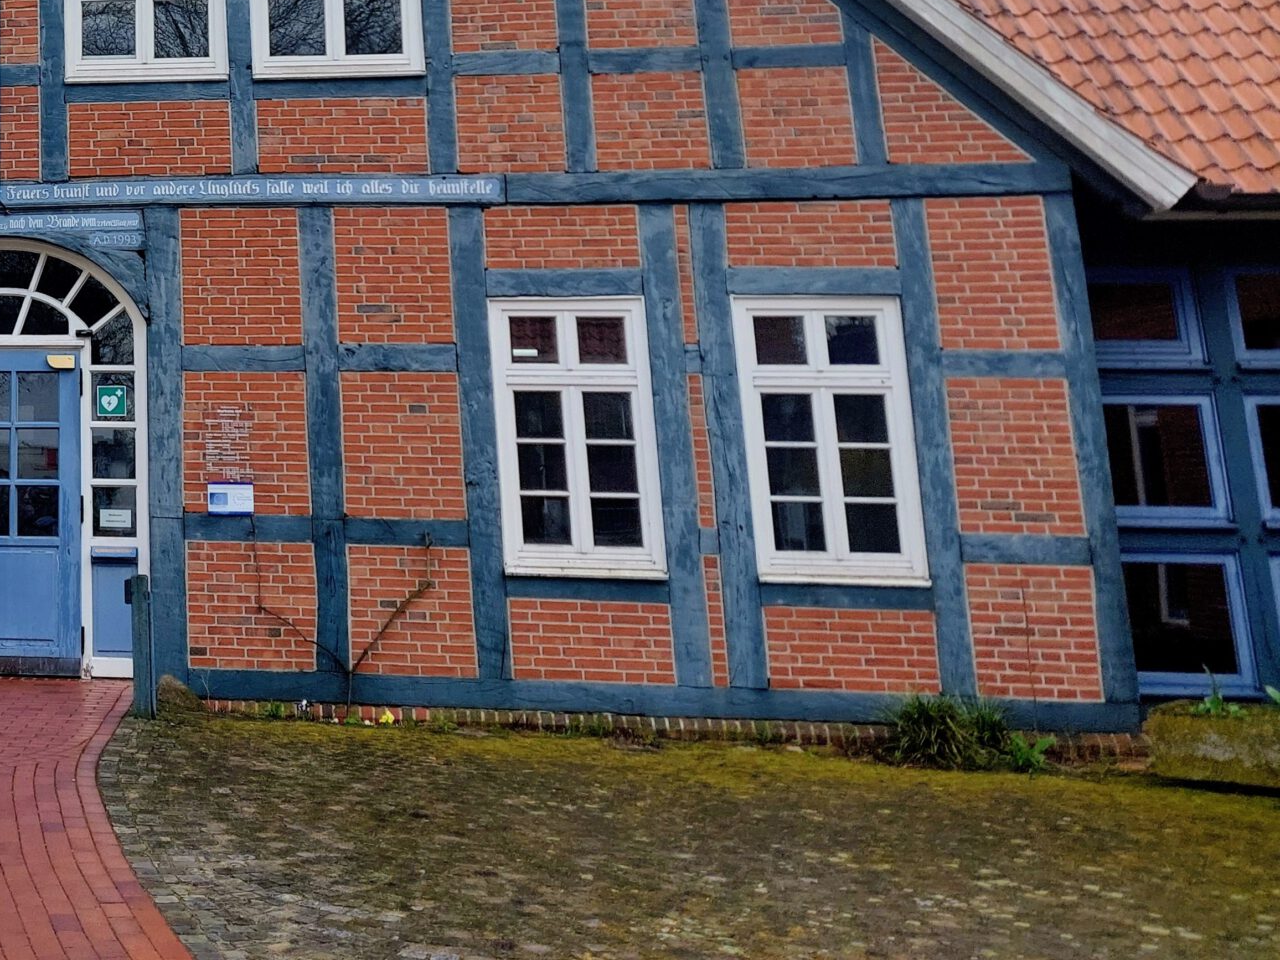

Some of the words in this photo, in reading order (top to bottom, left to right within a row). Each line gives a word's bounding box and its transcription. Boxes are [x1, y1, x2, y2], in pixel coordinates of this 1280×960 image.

[6, 185, 49, 200] Feuers
[53, 183, 91, 200] brunst
[96, 184, 119, 198] und
[126, 183, 146, 197] vor
[153, 181, 195, 195] andere
[302, 180, 329, 195] weil
[336, 179, 353, 196] ich
[362, 179, 393, 195] alles
[401, 179, 420, 195] dir
[28, 216, 43, 229] dem
[47, 215, 80, 228] Brande
[81, 216, 96, 227] vom
[113, 234, 137, 246] 1993
